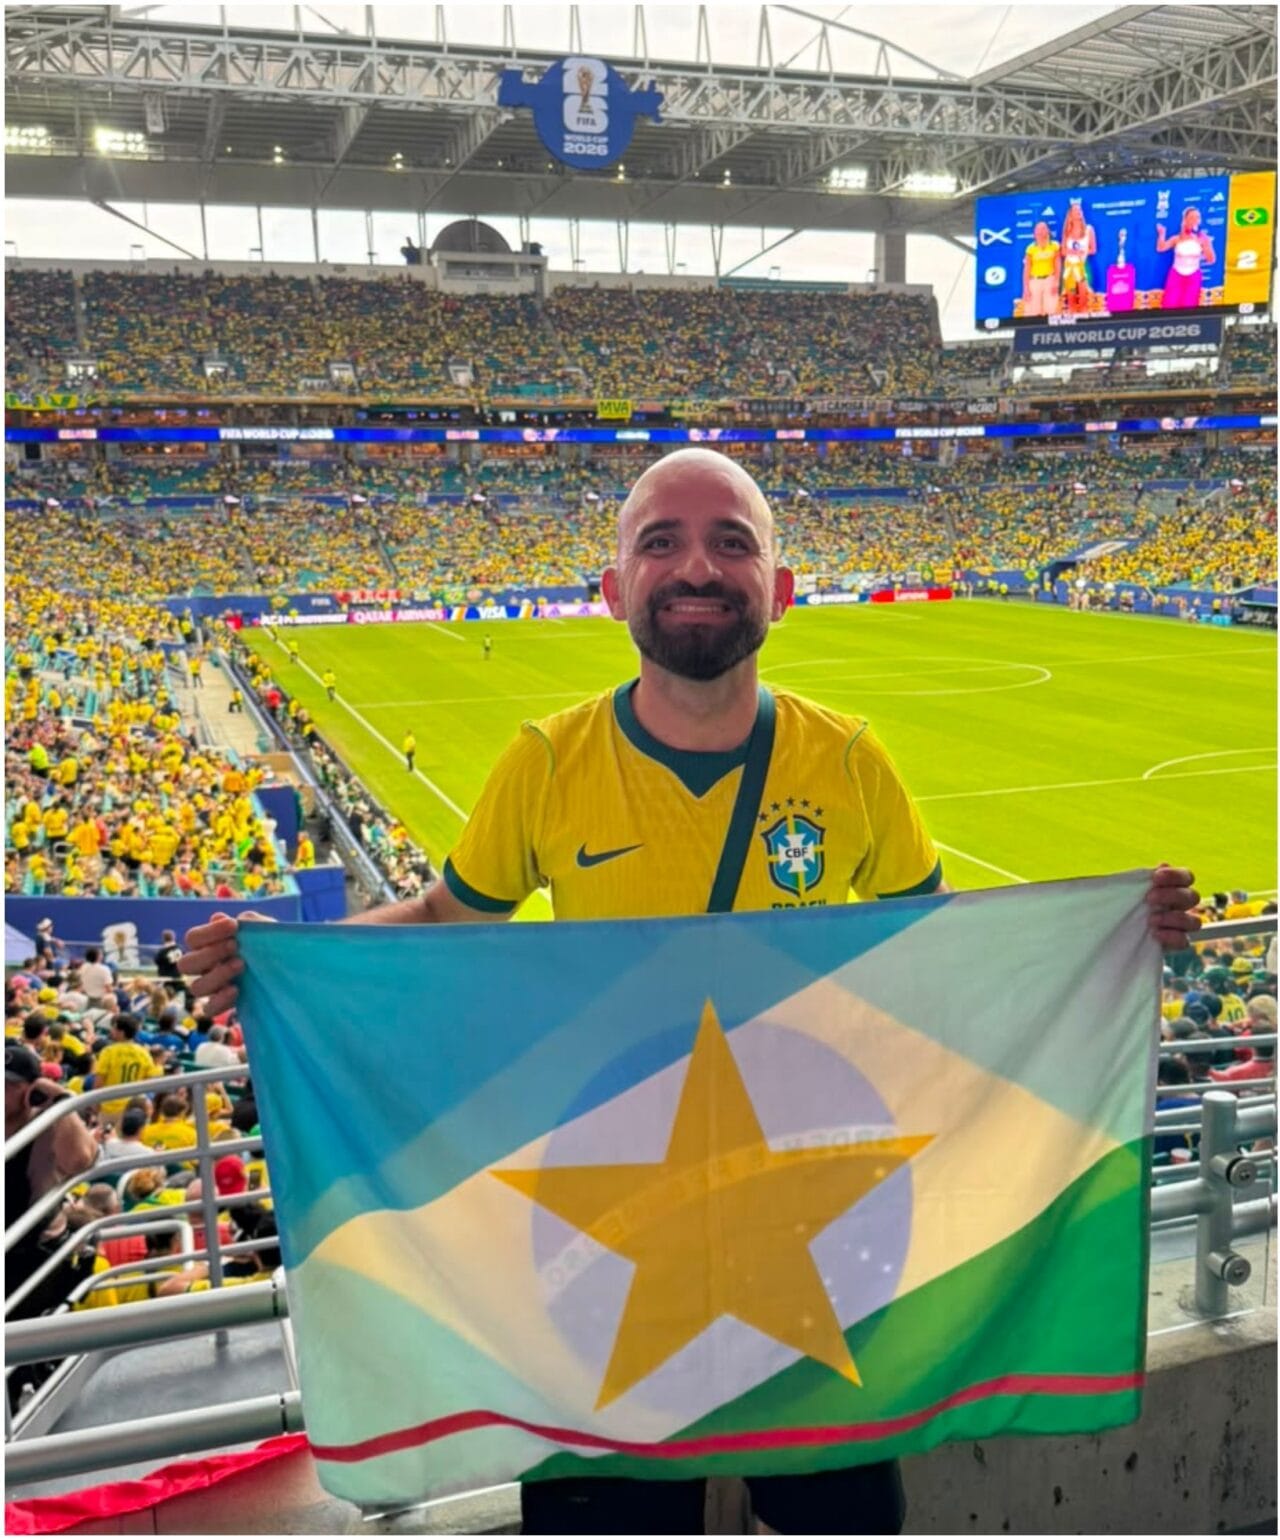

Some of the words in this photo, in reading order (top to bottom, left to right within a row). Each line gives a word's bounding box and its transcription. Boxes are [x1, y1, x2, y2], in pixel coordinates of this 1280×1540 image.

[576, 117, 597, 126] FIFA
[564, 134, 590, 142] WORLD
[563, 142, 609, 156] 2026
[1236, 250, 1260, 270] 2
[1032, 332, 1063, 345] FIFA
[1064, 330, 1115, 344] WORLD
[1117, 327, 1147, 340] CUP
[1149, 324, 1201, 339] 2026
[243, 428, 279, 440] WORLD
[353, 609, 393, 623] QATAR
[396, 608, 443, 622] AIRWAYS
[477, 606, 508, 619] VISA
[785, 846, 809, 859] CBF
[120, 1061, 141, 1084] 10
